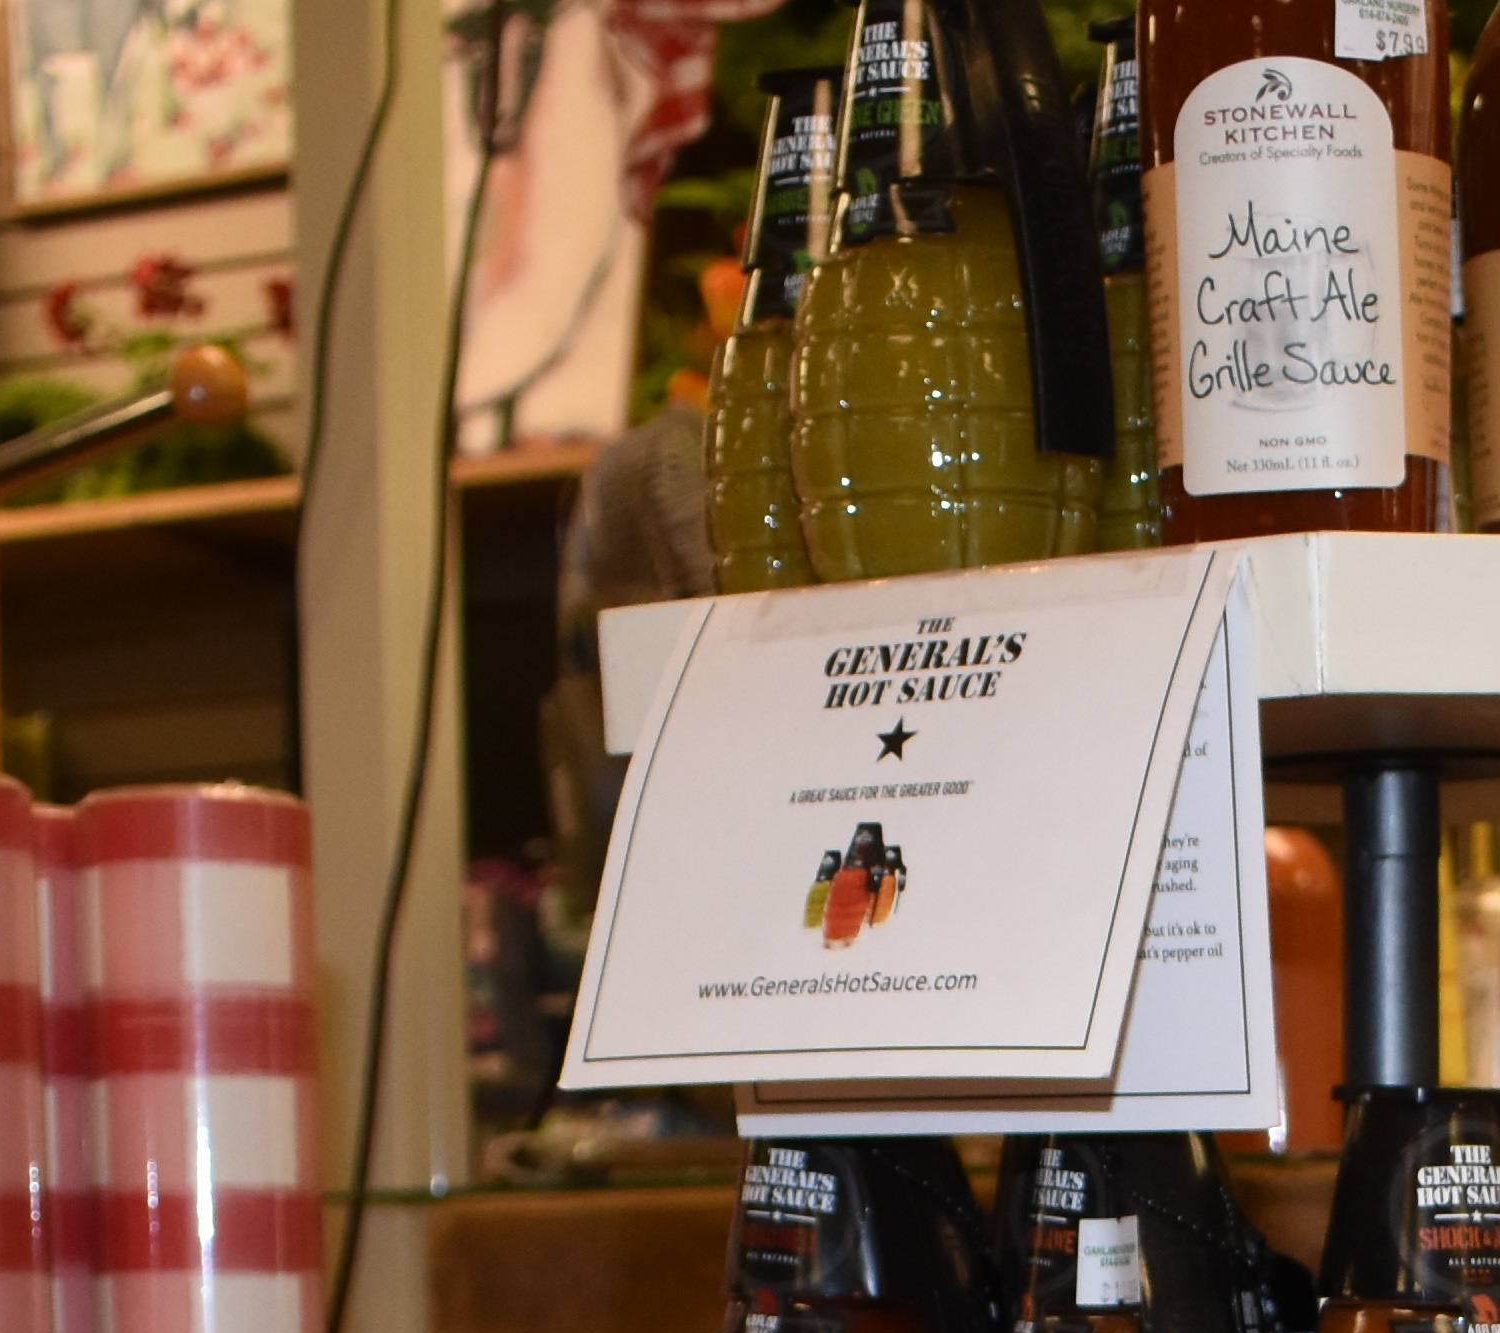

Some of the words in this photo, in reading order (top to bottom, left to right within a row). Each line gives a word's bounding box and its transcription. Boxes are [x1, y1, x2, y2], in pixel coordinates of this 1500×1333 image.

[1204, 104, 1356, 126] STONEWALL
[1225, 125, 1334, 144] KITCHEN
[1200, 146, 1246, 165] Creators
[1251, 148, 1262, 160] of
[1266, 144, 1322, 161] Specialty
[1327, 145, 1362, 158] Foods
[1209, 200, 1359, 258] Maine
[1197, 270, 1308, 325] Craft
[1310, 268, 1379, 323] Ale
[1189, 340, 1272, 398] Grille
[1282, 342, 1396, 385] Sauce
[1259, 438, 1290, 448] NON
[1295, 436, 1327, 446] GMO
[917, 616, 956, 634] THE
[824, 632, 1027, 678] GENERAL'S
[824, 679, 891, 709] HOT
[896, 671, 1002, 705] SAUCE
[798, 789, 827, 803] GREAT
[828, 788, 858, 801] SAUCE
[859, 786, 878, 800] FOR
[881, 784, 898, 798] THE
[900, 782, 940, 797] GREATER
[1165, 858, 1198, 873] aging
[1163, 945, 1204, 963] pepper
[698, 967, 978, 1001] www.GeneralsHotSauce.com
[768, 1148, 808, 1170] THE
[1450, 1145, 1491, 1165] THE
[1417, 1186, 1462, 1207] HOT
